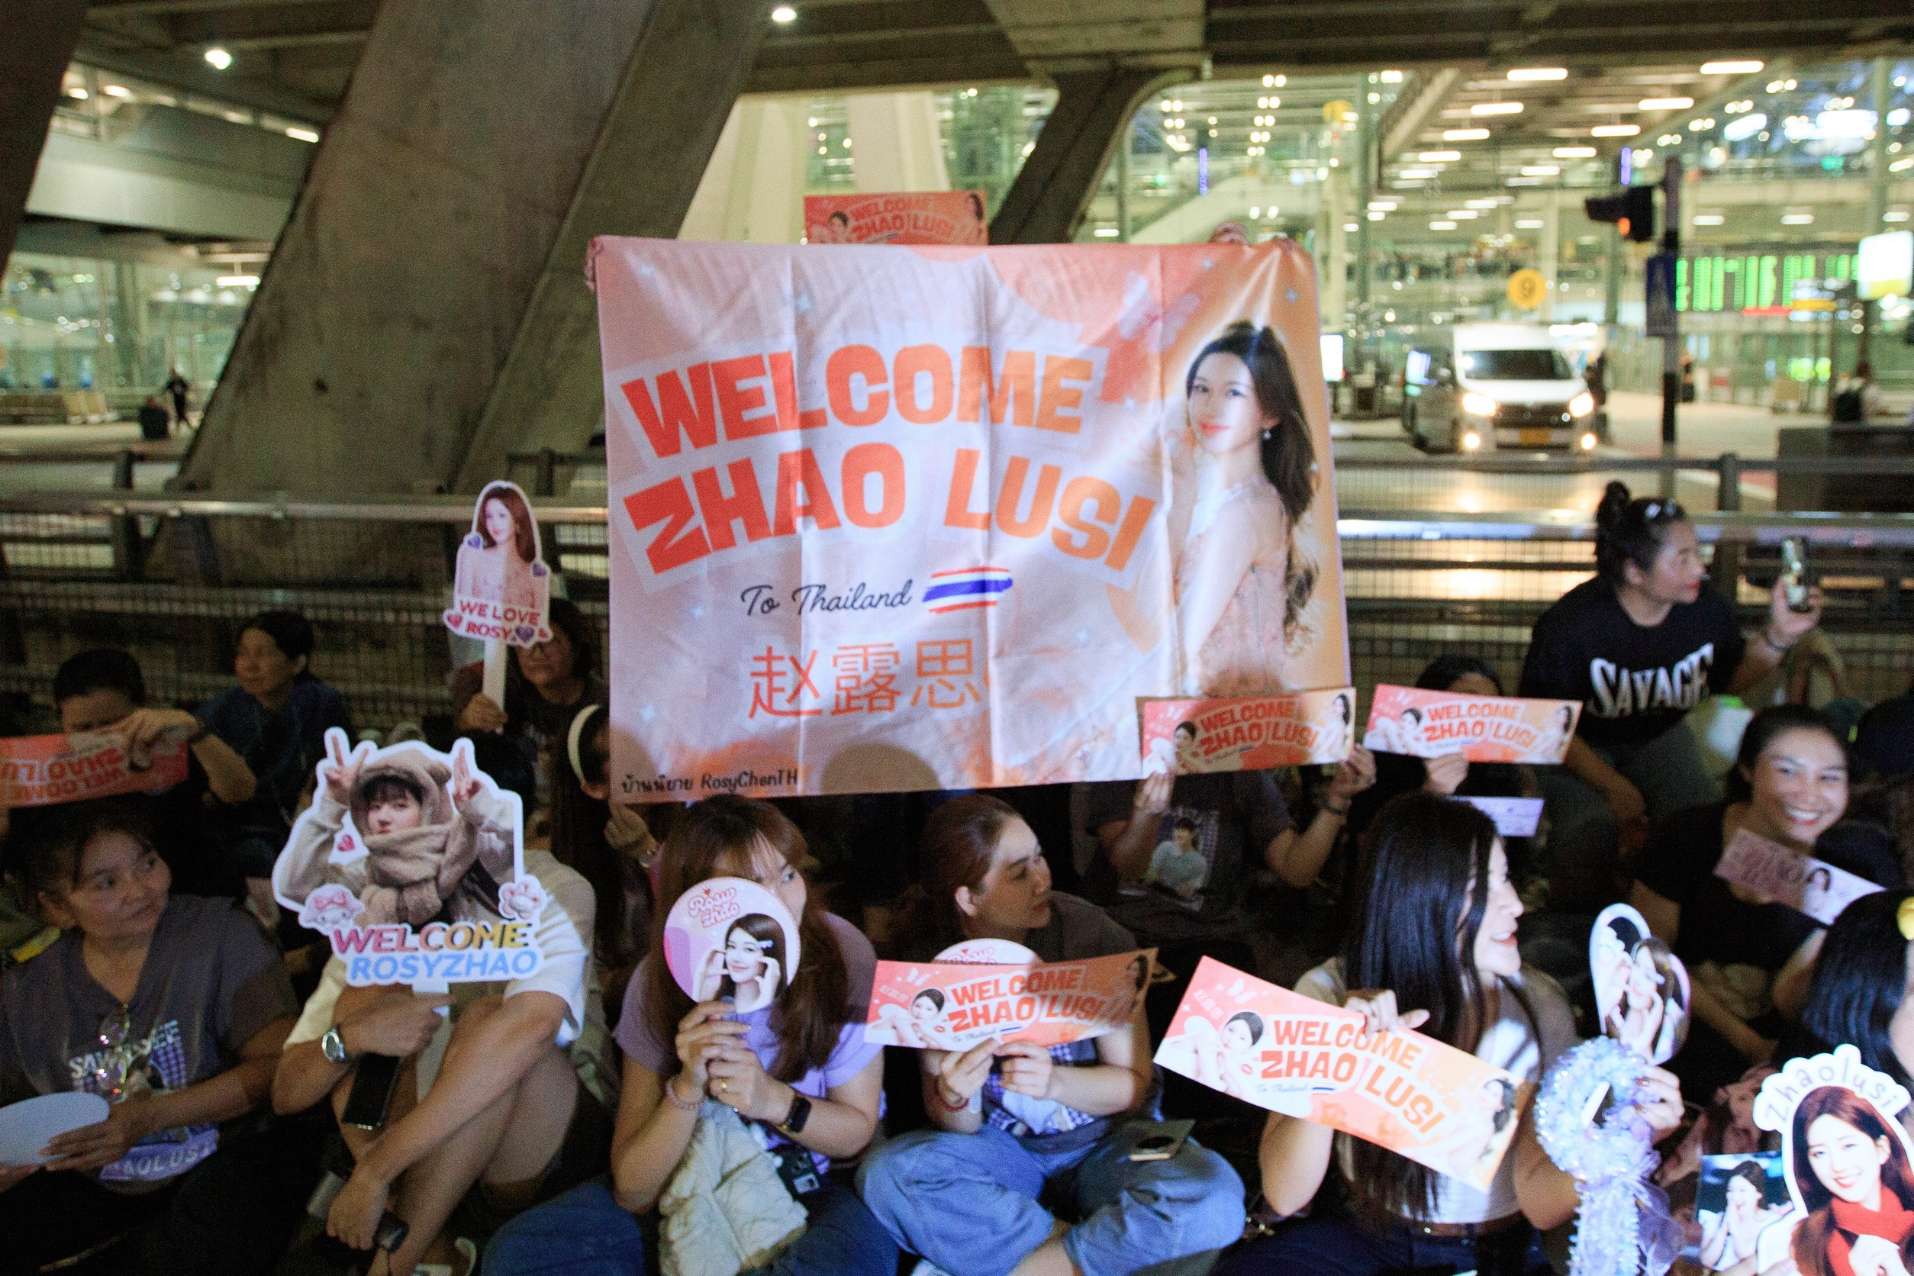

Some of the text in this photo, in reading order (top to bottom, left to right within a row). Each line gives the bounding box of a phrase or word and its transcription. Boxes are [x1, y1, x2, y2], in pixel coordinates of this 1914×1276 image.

[620, 343, 1094, 459] WELCOME
[622, 442, 1156, 575] ZHAO LUSI
[460, 601, 541, 625] WE LOVE
[740, 578, 914, 616] To Thailand
[465, 621, 512, 640] ROSY
[748, 639, 982, 719] 赵露思
[1200, 701, 1297, 733] WELCOME
[1428, 703, 1518, 721] WELCOME
[1200, 722, 1263, 757] ZHAO
[1271, 721, 1318, 749] LUSI
[1424, 720, 1537, 749] ZHAO LUSI
[331, 922, 533, 954] WELCOME
[350, 950, 538, 981] ROSYZHAO
[951, 967, 1083, 1006] WELCOME
[949, 997, 1037, 1033] ZHAO
[1273, 1019, 1423, 1071] WELCOME
[1261, 1049, 1446, 1135] ZHAO LUSI
